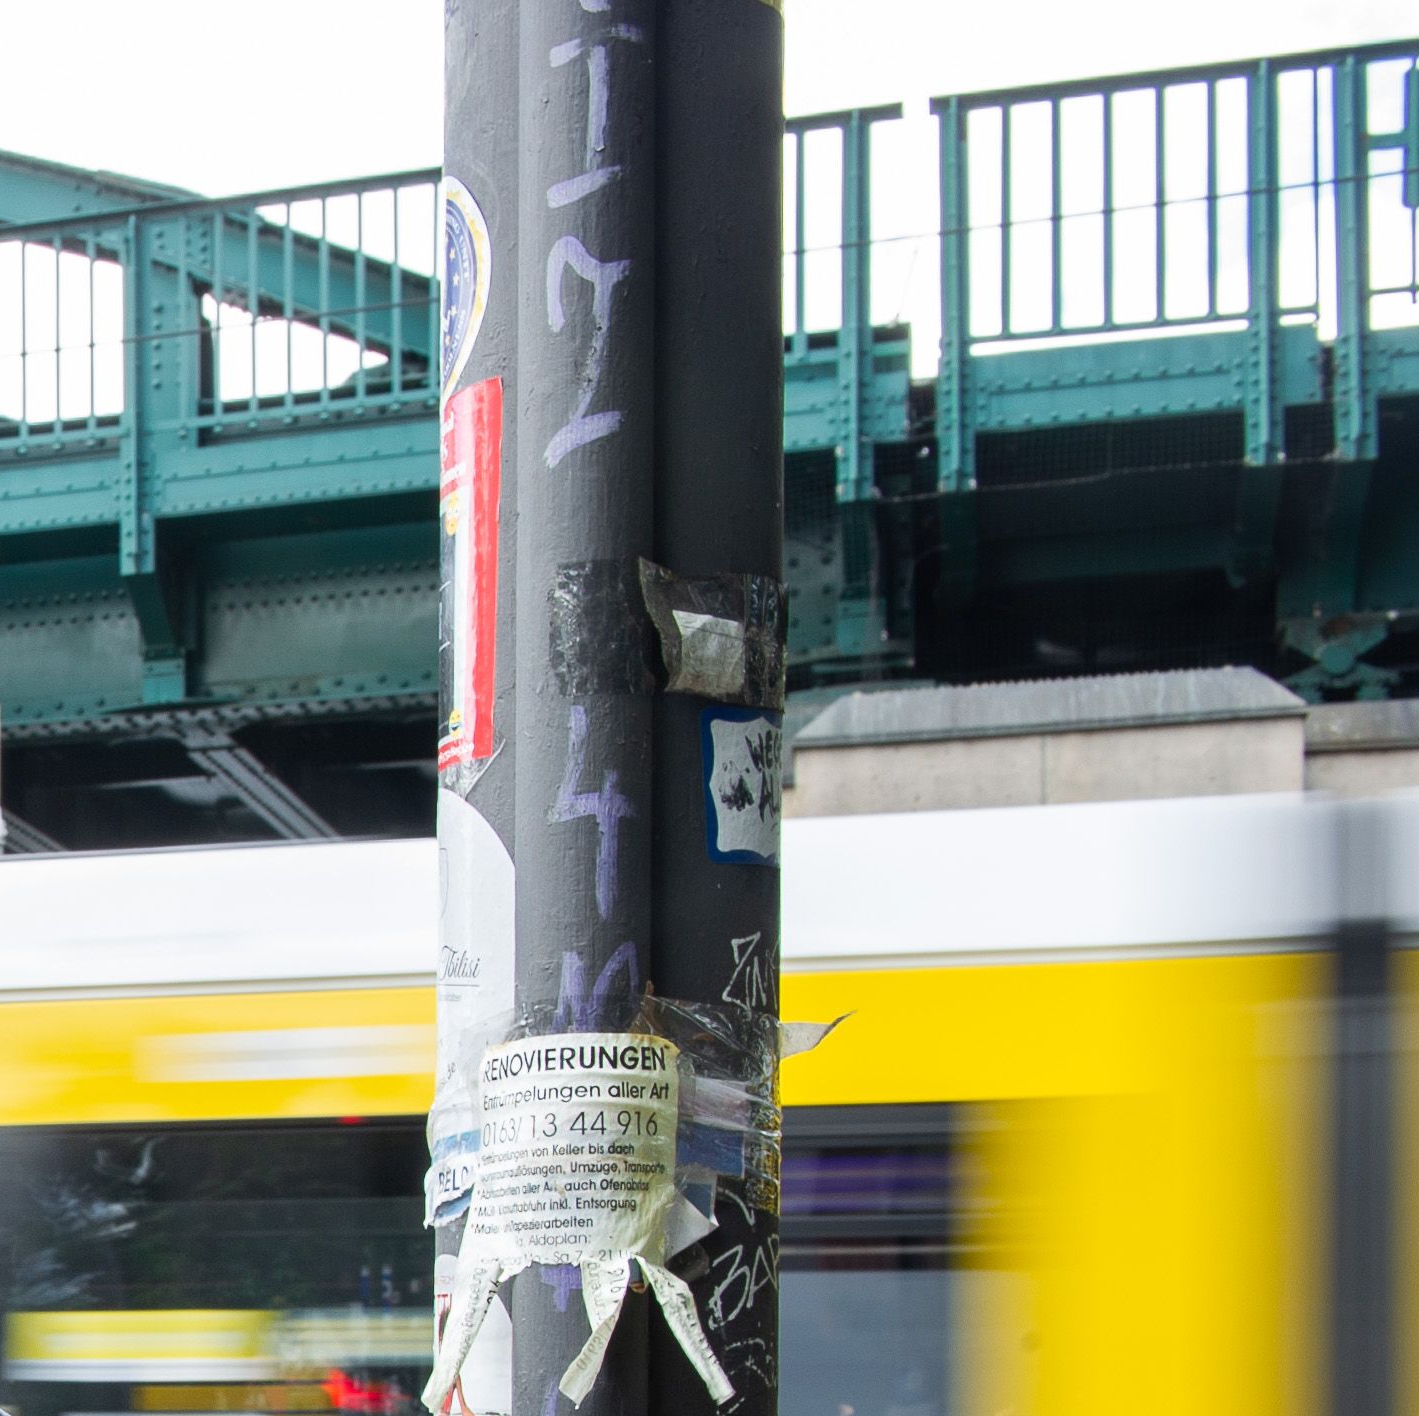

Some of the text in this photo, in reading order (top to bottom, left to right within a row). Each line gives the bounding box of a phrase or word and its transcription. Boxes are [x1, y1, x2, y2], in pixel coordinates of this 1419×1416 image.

[441, 944, 481, 982] Tbilisi
[482, 1045, 667, 1084] RENOVIERUNGEN
[483, 1081, 670, 1111] Entrümpelungen aller Art
[569, 1110, 607, 1136] 44
[617, 1110, 658, 1137] 916
[531, 1145, 549, 1158] von
[552, 1144, 584, 1156] Keller
[588, 1143, 604, 1155] bis
[608, 1142, 635, 1155] dach
[570, 1160, 621, 1177] Umzüge,
[564, 1179, 597, 1192] auch
[549, 1198, 572, 1211] inkl.
[575, 1196, 637, 1212] Entsorgung
[528, 1232, 592, 1247] Aldoplan:
